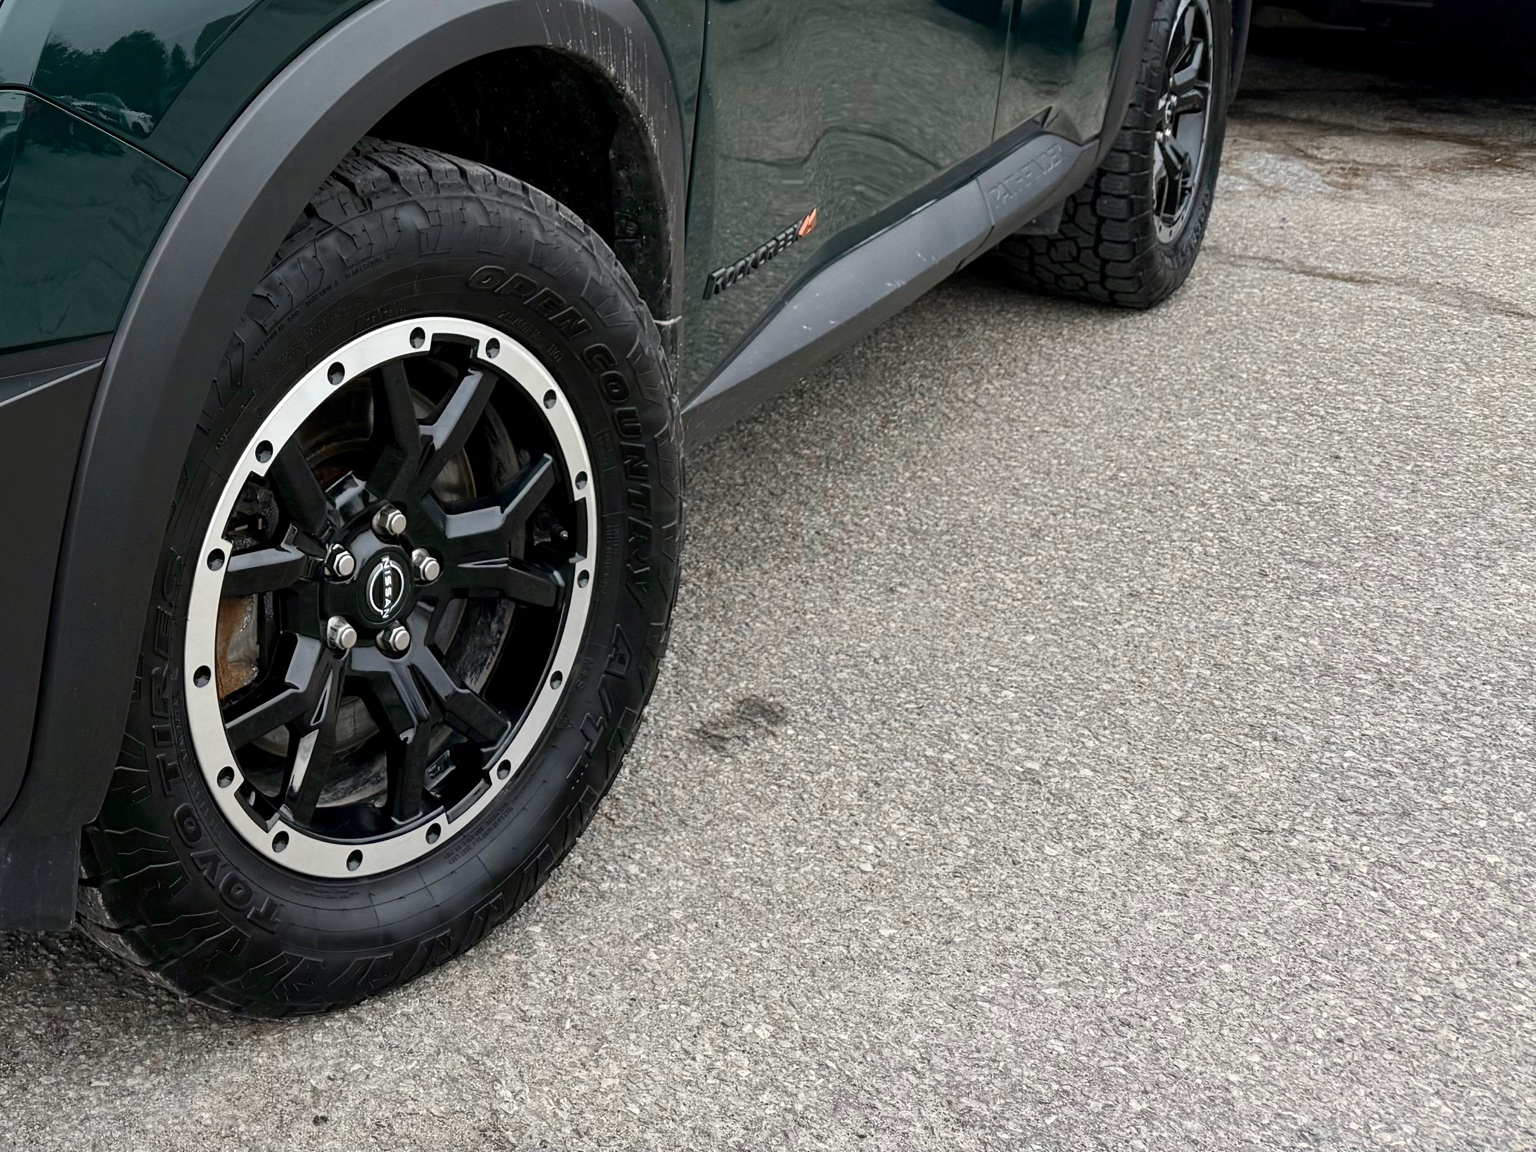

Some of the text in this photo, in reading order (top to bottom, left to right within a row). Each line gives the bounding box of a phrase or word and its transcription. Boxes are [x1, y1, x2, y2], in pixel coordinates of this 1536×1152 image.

[466, 263, 593, 342] OPEN
[581, 341, 657, 611] COUNTRY
[150, 545, 186, 798] TIRES
[381, 554, 393, 619] NISSAN
[172, 801, 283, 935] TOYO
